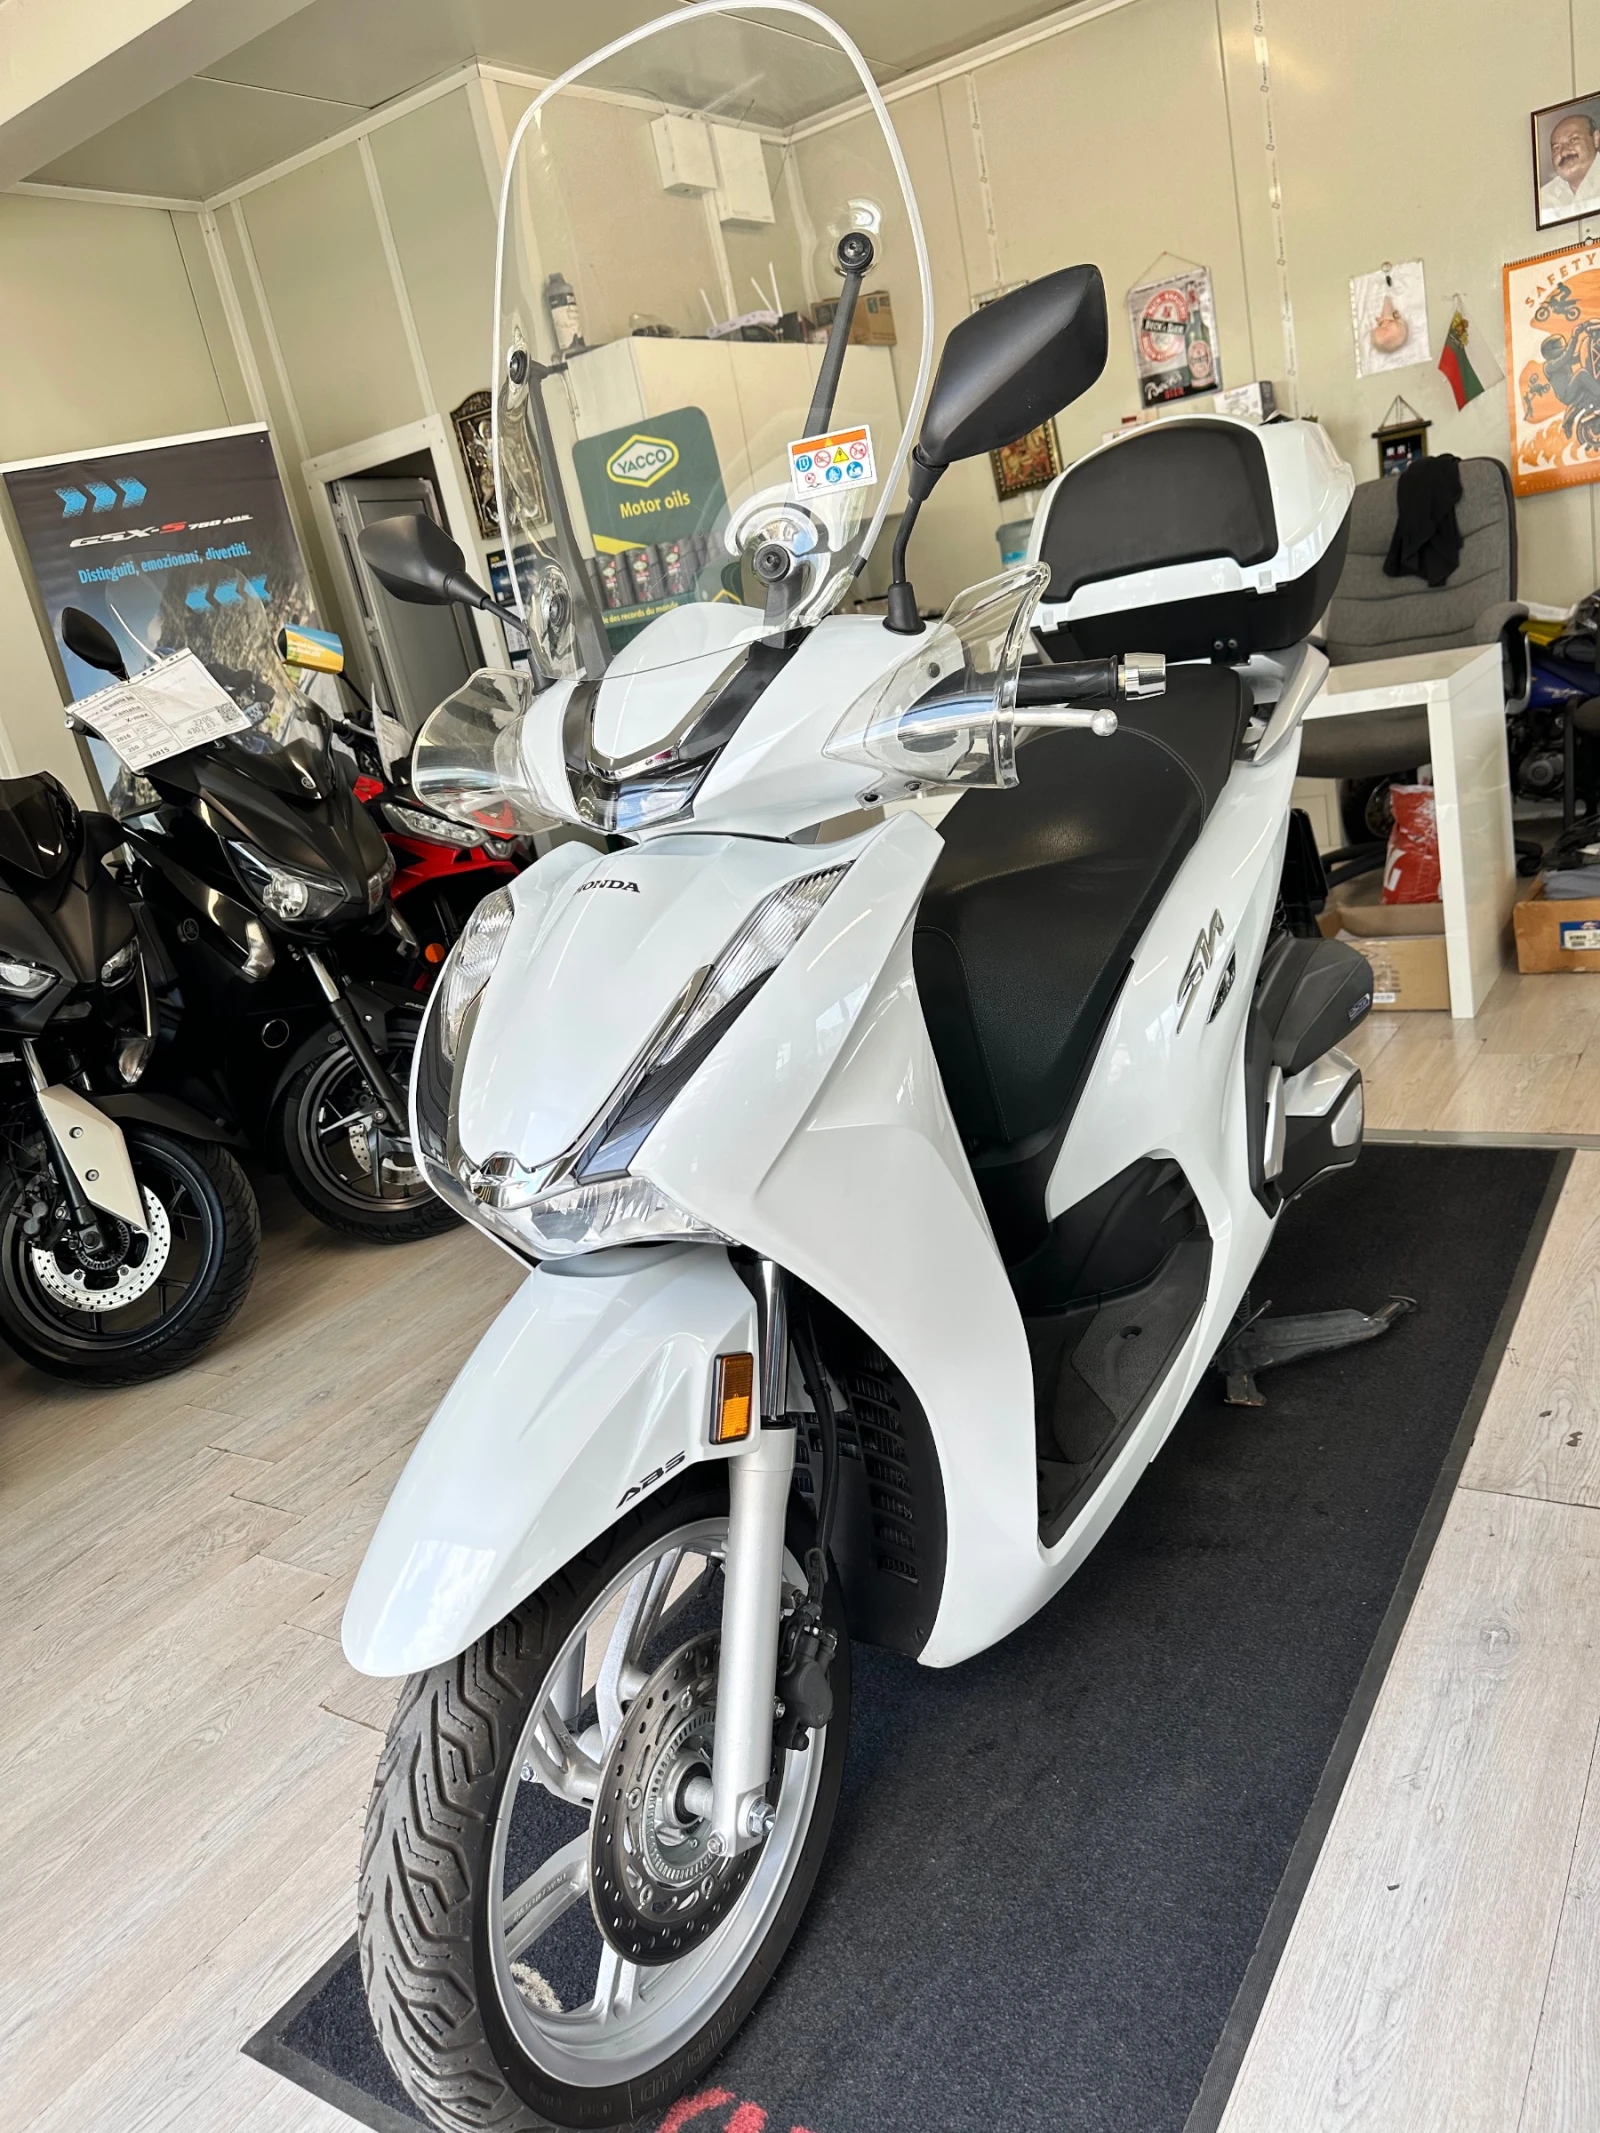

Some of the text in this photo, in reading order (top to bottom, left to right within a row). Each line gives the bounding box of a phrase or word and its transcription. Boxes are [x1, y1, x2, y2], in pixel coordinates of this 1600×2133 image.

[1525, 252, 1597, 308] SAFETY
[617, 448, 667, 475] YACCO
[619, 490, 691, 519] Motor oils
[69, 522, 188, 548] GSX-S
[78, 542, 252, 585] Distinguiti, emozionati, divertiti.
[621, 607, 646, 622] records
[646, 605, 655, 616] du
[112, 705, 142, 718] Yamaha
[125, 713, 149, 723] X-max
[147, 746, 170, 760] 34915
[615, 1450, 686, 1510] ABS
